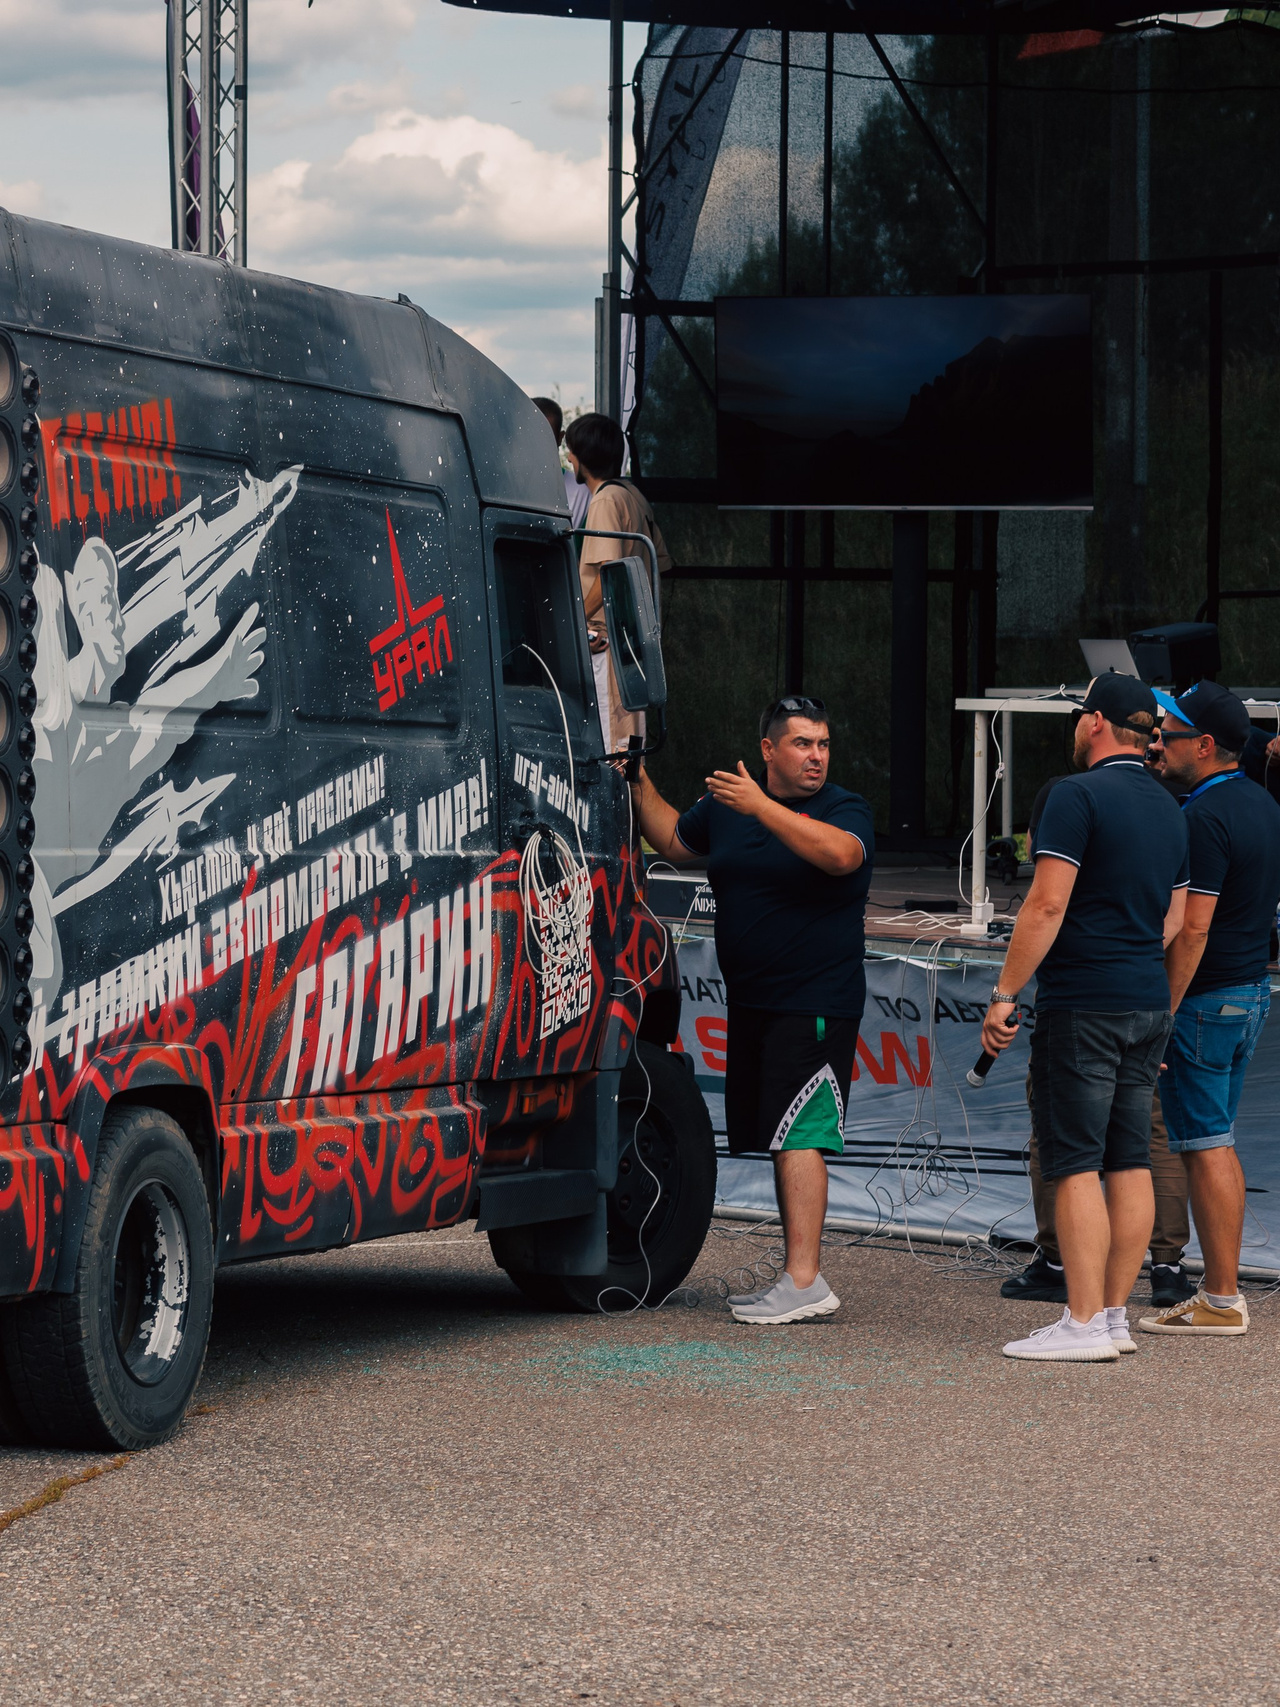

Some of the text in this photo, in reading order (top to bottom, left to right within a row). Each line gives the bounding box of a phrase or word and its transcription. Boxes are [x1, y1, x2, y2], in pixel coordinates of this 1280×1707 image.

[372, 614, 453, 713] УРАЛ
[247, 824, 265, 870] У
[297, 753, 386, 845] ПРОБЛЕМЫ!
[282, 873, 492, 1105] ГАГАРИН
[872, 994, 922, 1022] ПО
